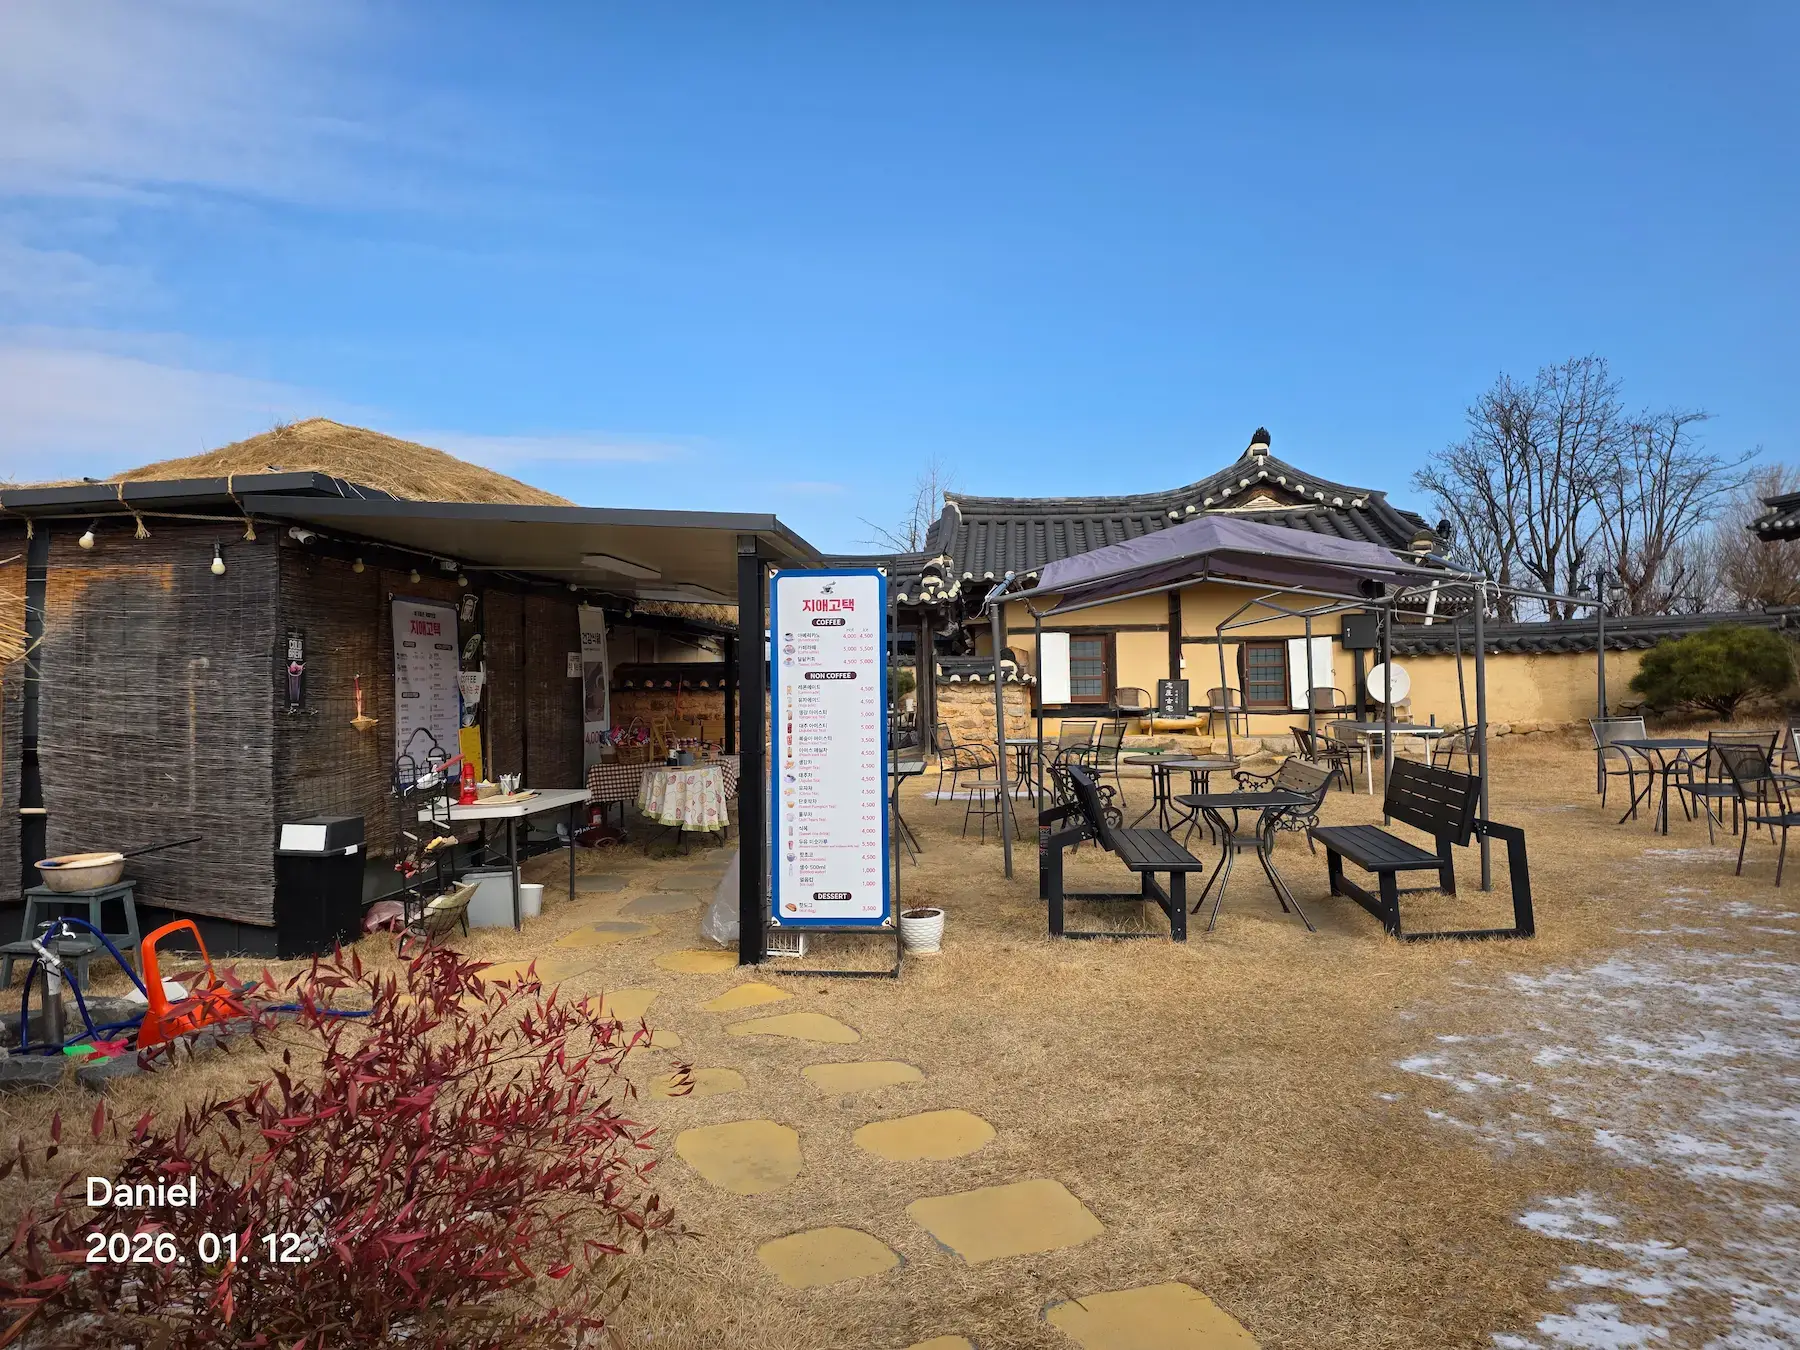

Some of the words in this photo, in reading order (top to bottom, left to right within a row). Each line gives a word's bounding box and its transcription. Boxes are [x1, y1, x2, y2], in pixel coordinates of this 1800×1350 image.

[802, 599, 855, 612] 지애고택
[410, 620, 442, 636] 지애고택
[289, 640, 302, 649] COLD
[288, 649, 302, 658] BREW
